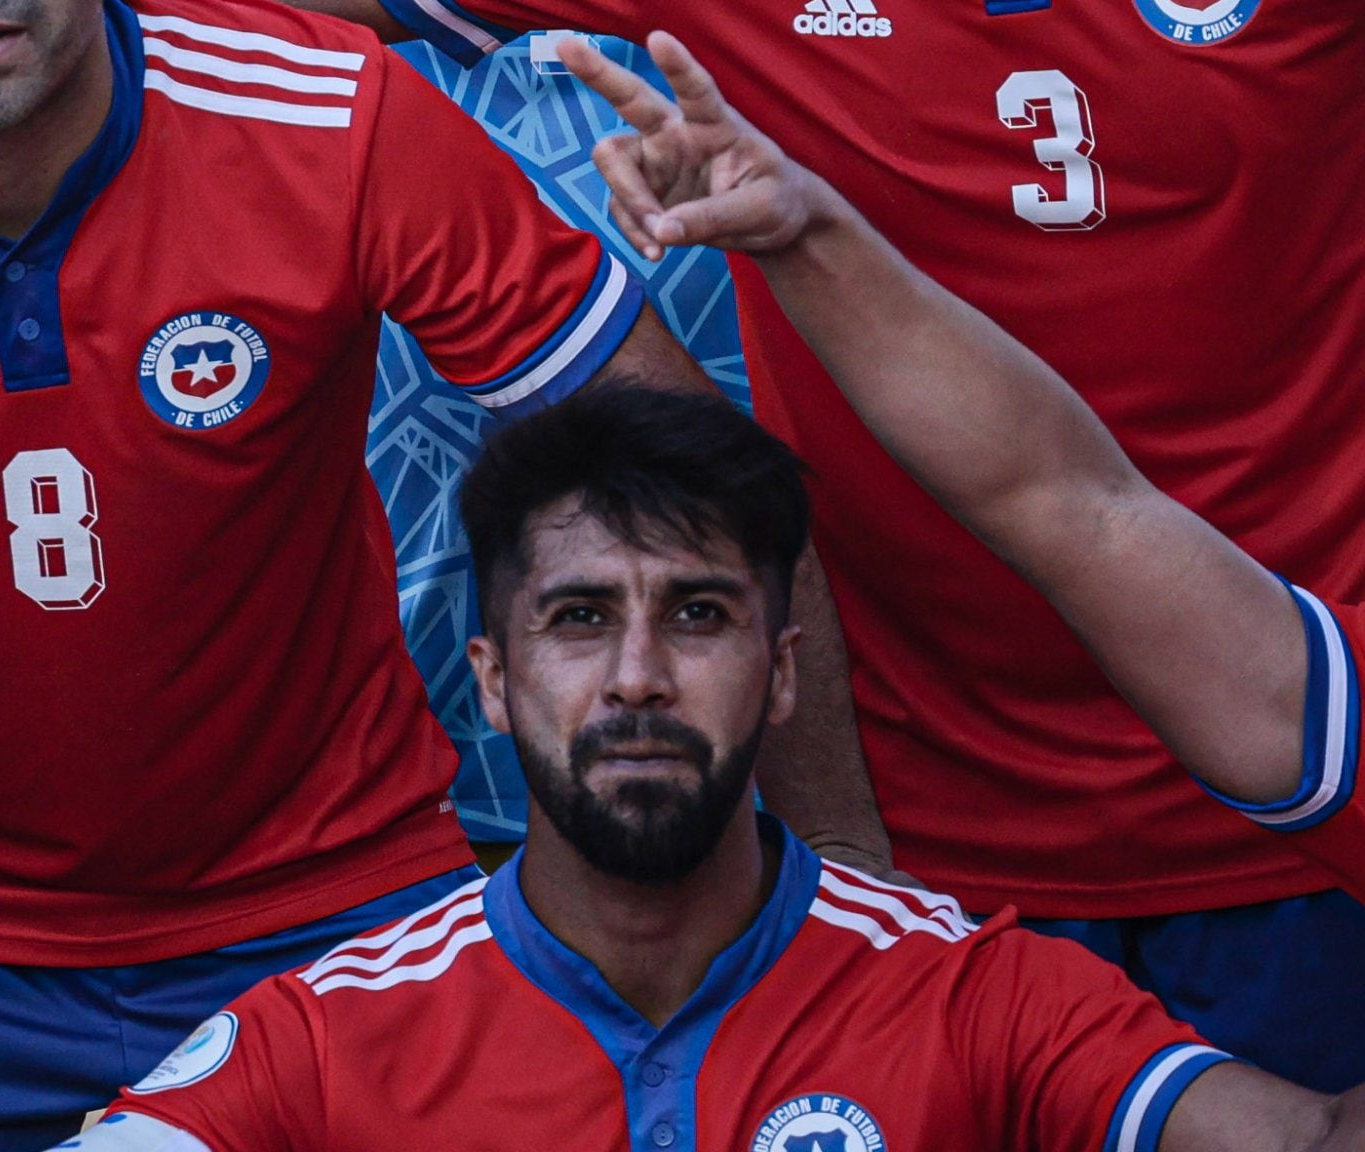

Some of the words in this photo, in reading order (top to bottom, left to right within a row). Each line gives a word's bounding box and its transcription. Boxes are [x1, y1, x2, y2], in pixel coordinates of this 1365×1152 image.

[793, 11, 892, 37] adidas
[1173, 23, 1194, 41] DE
[1201, 13, 1242, 41] CHILE
[995, 69, 1107, 232] 3
[140, 314, 202, 377] FEDERACION
[212, 314, 231, 328] DE
[234, 323, 268, 363] FUTBOL
[175, 411, 195, 427] DE
[203, 400, 242, 427] CHILE
[2, 447, 106, 611] 8
[754, 1098, 812, 1152] DERACION
[821, 1097, 841, 1113] DE
[844, 1105, 883, 1152] FUTBOL
